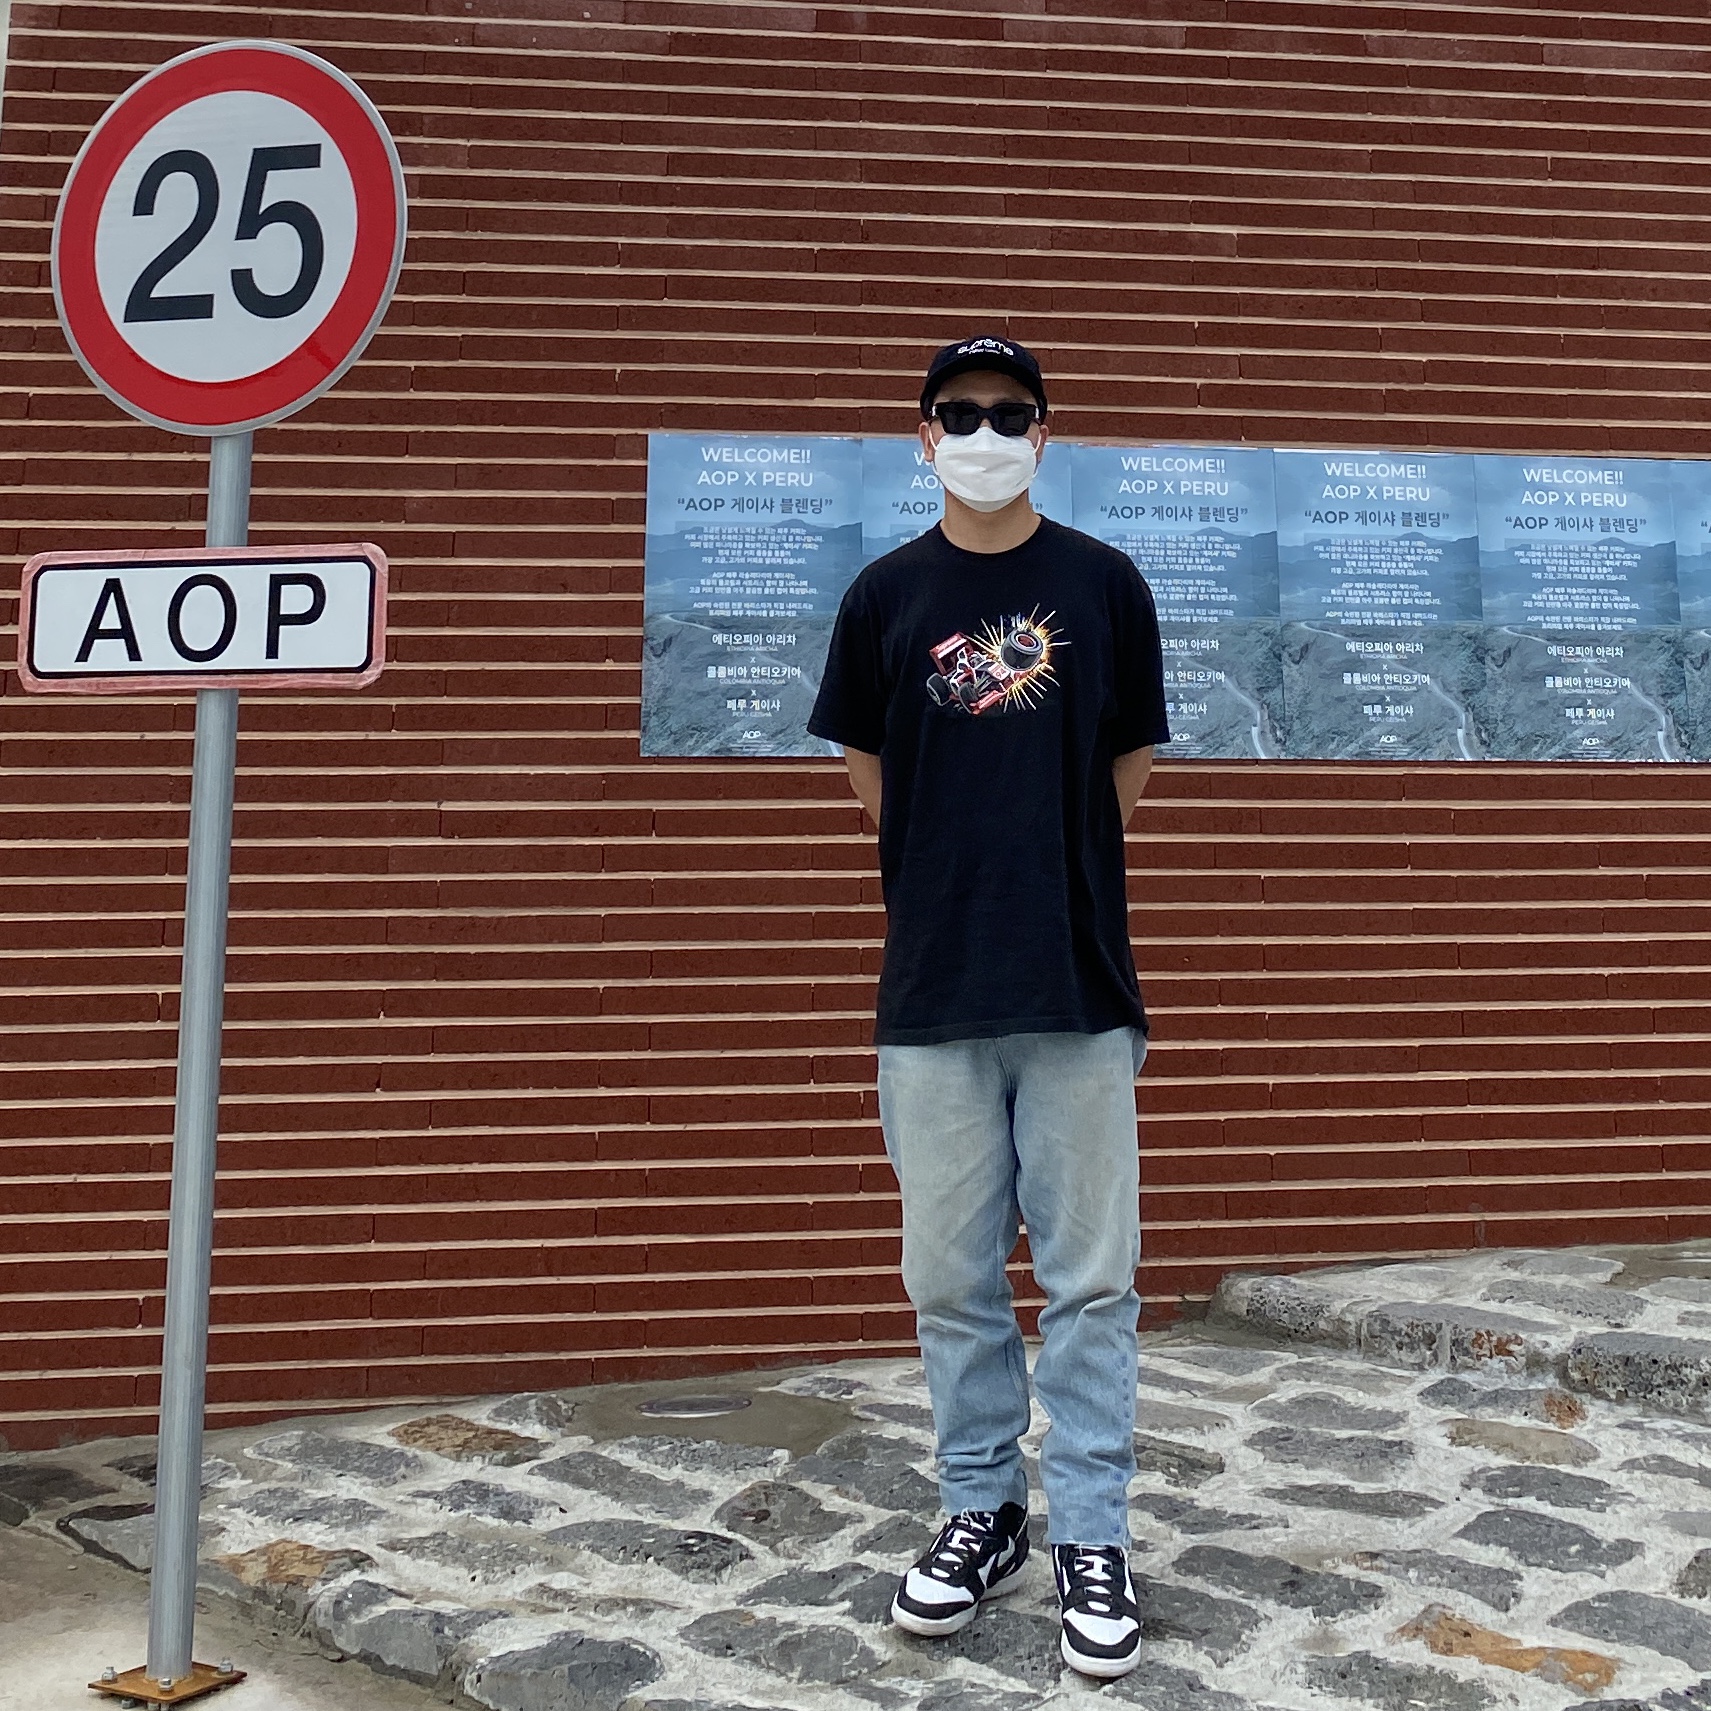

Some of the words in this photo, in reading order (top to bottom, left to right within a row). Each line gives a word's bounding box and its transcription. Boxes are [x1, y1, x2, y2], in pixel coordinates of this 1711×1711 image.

[123, 143, 324, 323] 25
[701, 447, 811, 464] WELCOME!!
[1120, 456, 1226, 473] WELCOME!!
[1324, 462, 1427, 479] WELCOME!!
[697, 471, 739, 486] AOP
[762, 472, 813, 487] PERU
[1522, 468, 1624, 485] WELCOME!!
[1118, 480, 1158, 494] AOP
[1180, 481, 1229, 496] PERU
[1322, 485, 1361, 499] AOP
[1382, 486, 1431, 501] PERU
[730, 497, 775, 514] 게이샤
[1521, 490, 1560, 505] AOP
[1580, 492, 1627, 508] PERU
[1150, 505, 1194, 522] 게이샤
[1354, 510, 1396, 527] 게이샤
[1554, 515, 1594, 532] 게이샤
[75, 572, 327, 663] AOP
[712, 634, 764, 646] 에티오피아
[765, 634, 796, 646] 아리차
[1190, 639, 1220, 651] 아리차
[1346, 642, 1393, 653] 에티오피아
[1396, 642, 1424, 654] 아리차
[1547, 646, 1594, 657] 에티오피아
[1595, 646, 1624, 658] 아리차
[750, 666, 801, 679] 안티오키아
[1177, 671, 1225, 683] 안티오키아
[1384, 673, 1430, 686] 안티오키아
[1584, 676, 1631, 689] 안티오키아
[749, 699, 781, 711] 게이샤
[1178, 702, 1208, 715] 게이샤
[1385, 704, 1414, 717] 게이샤
[1586, 708, 1615, 720] 게이샤
